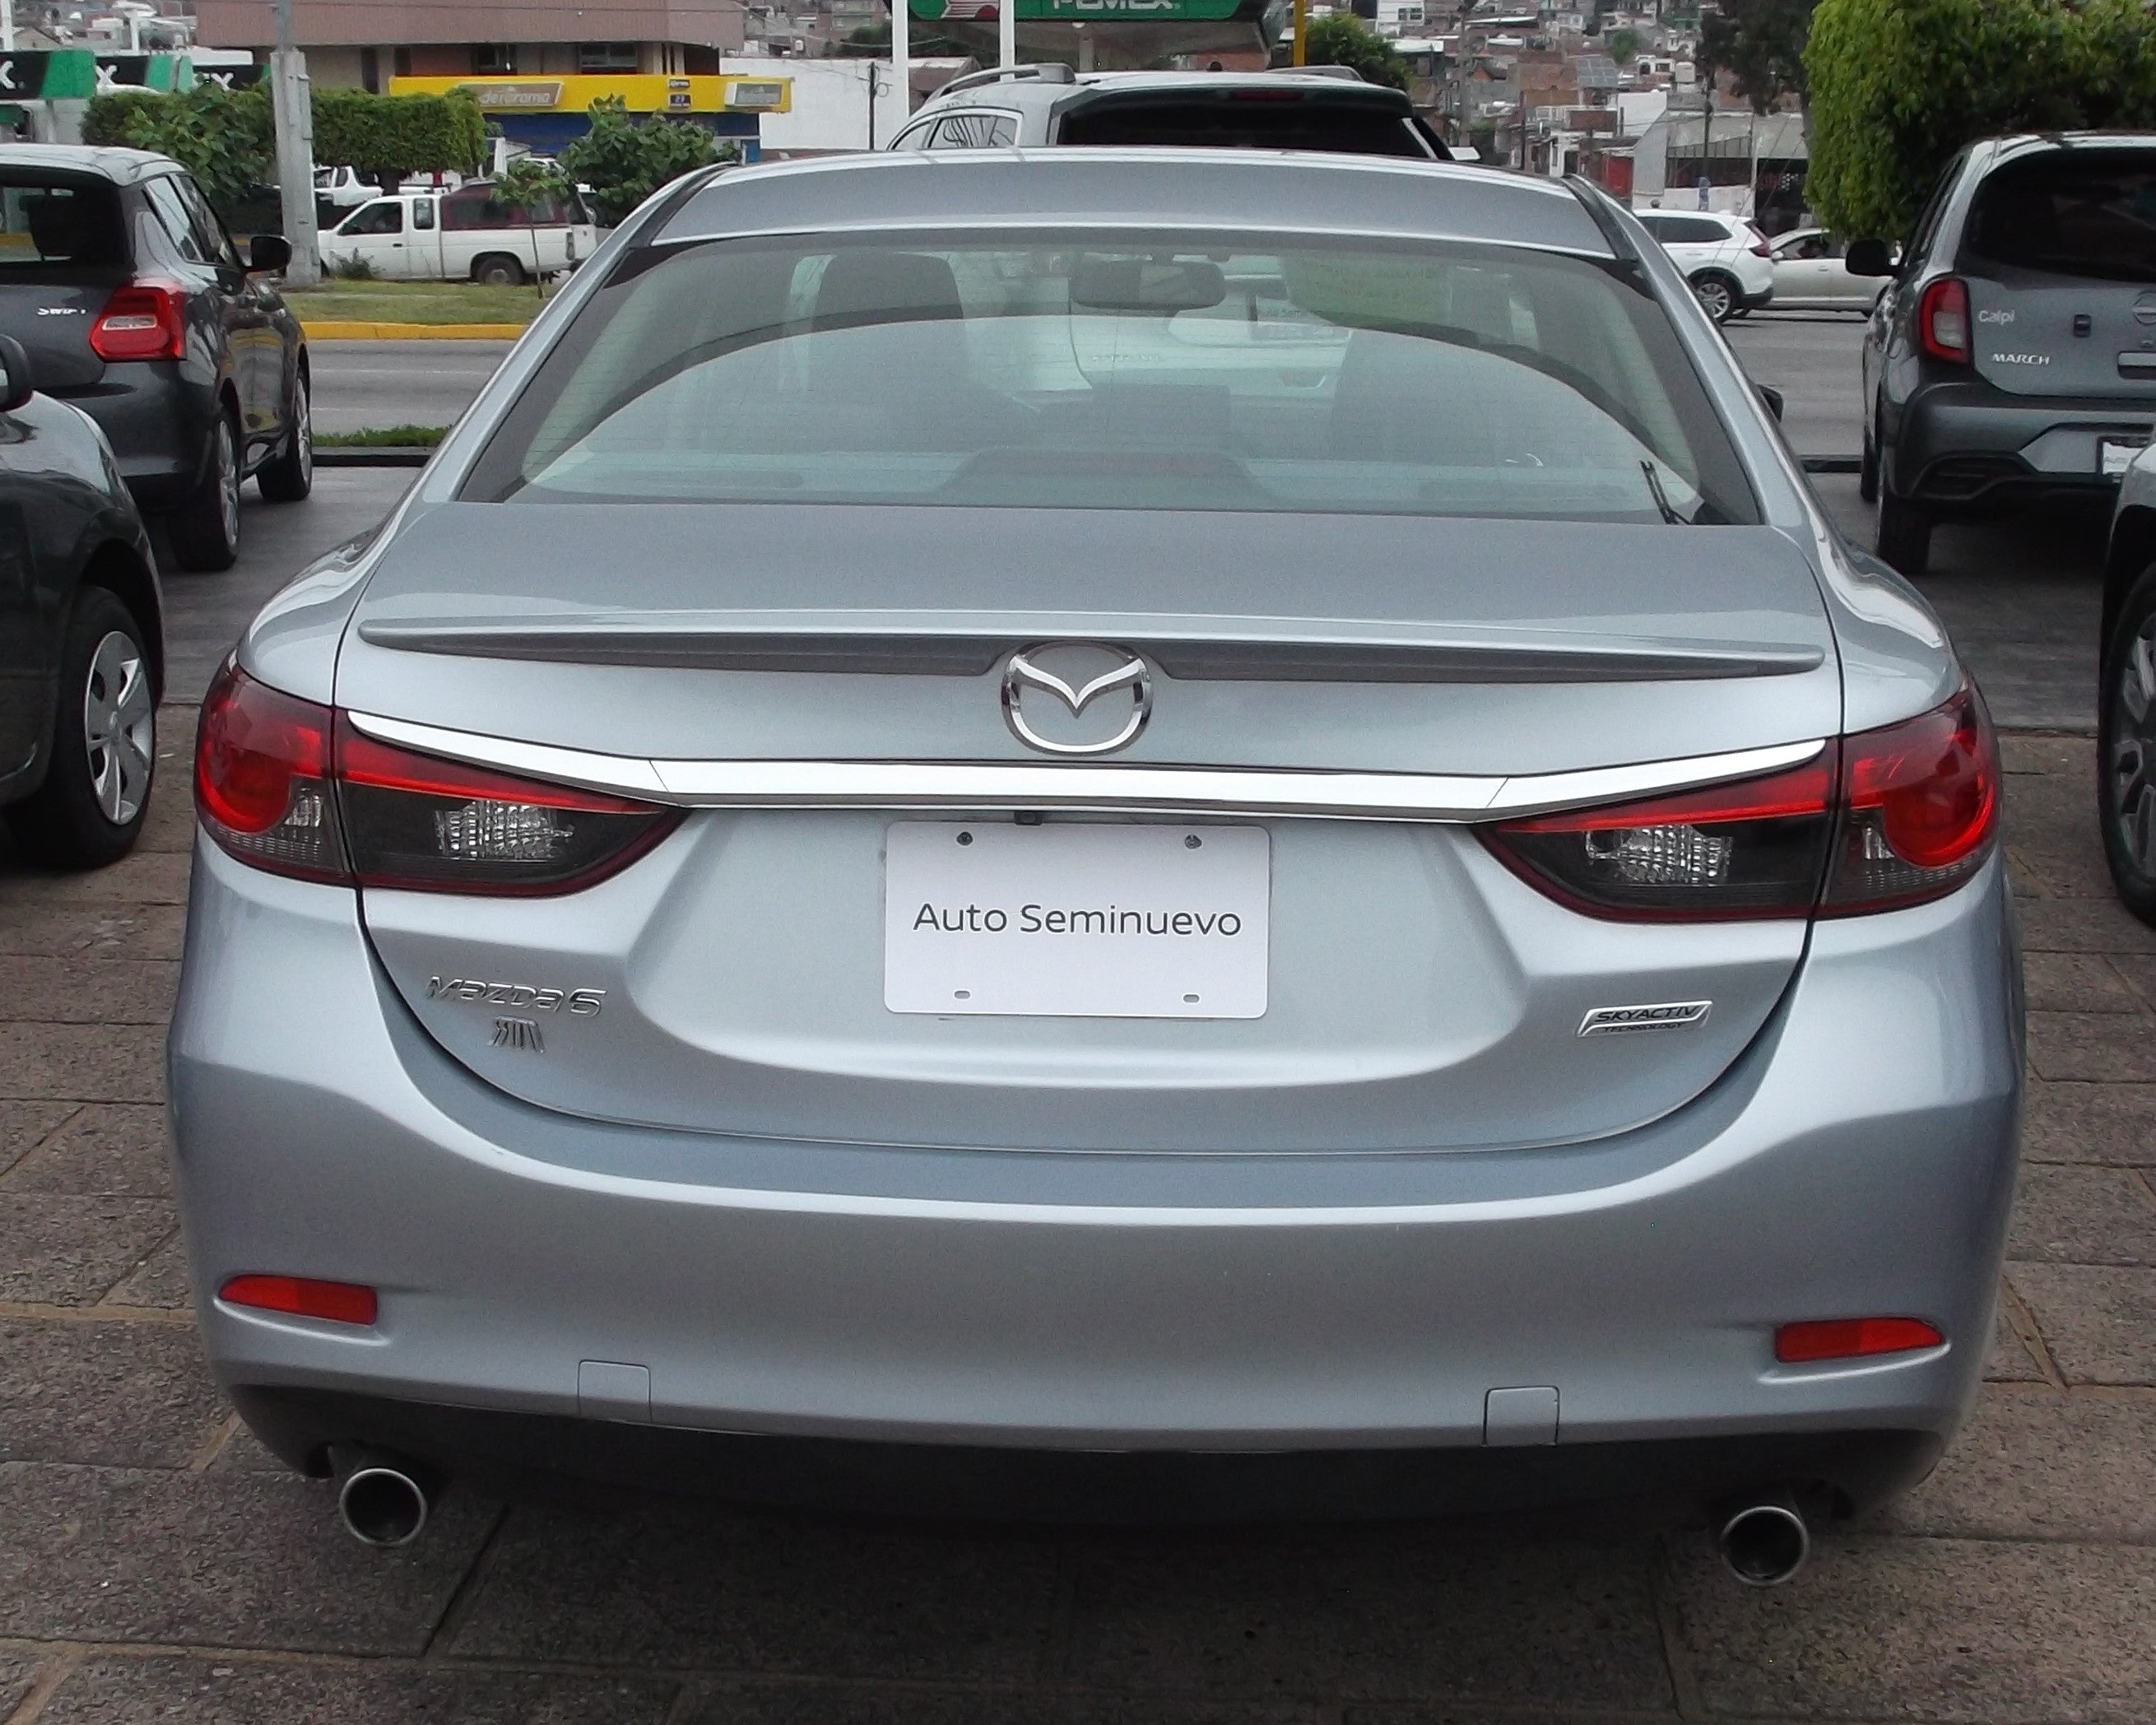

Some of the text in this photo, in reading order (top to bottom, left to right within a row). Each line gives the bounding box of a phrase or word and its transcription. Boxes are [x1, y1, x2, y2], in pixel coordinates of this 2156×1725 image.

[1991, 352, 2050, 365] MARCH
[913, 903, 1242, 937] Auto Seminuevo
[1595, 1007, 1699, 1022] SKYACTIV
